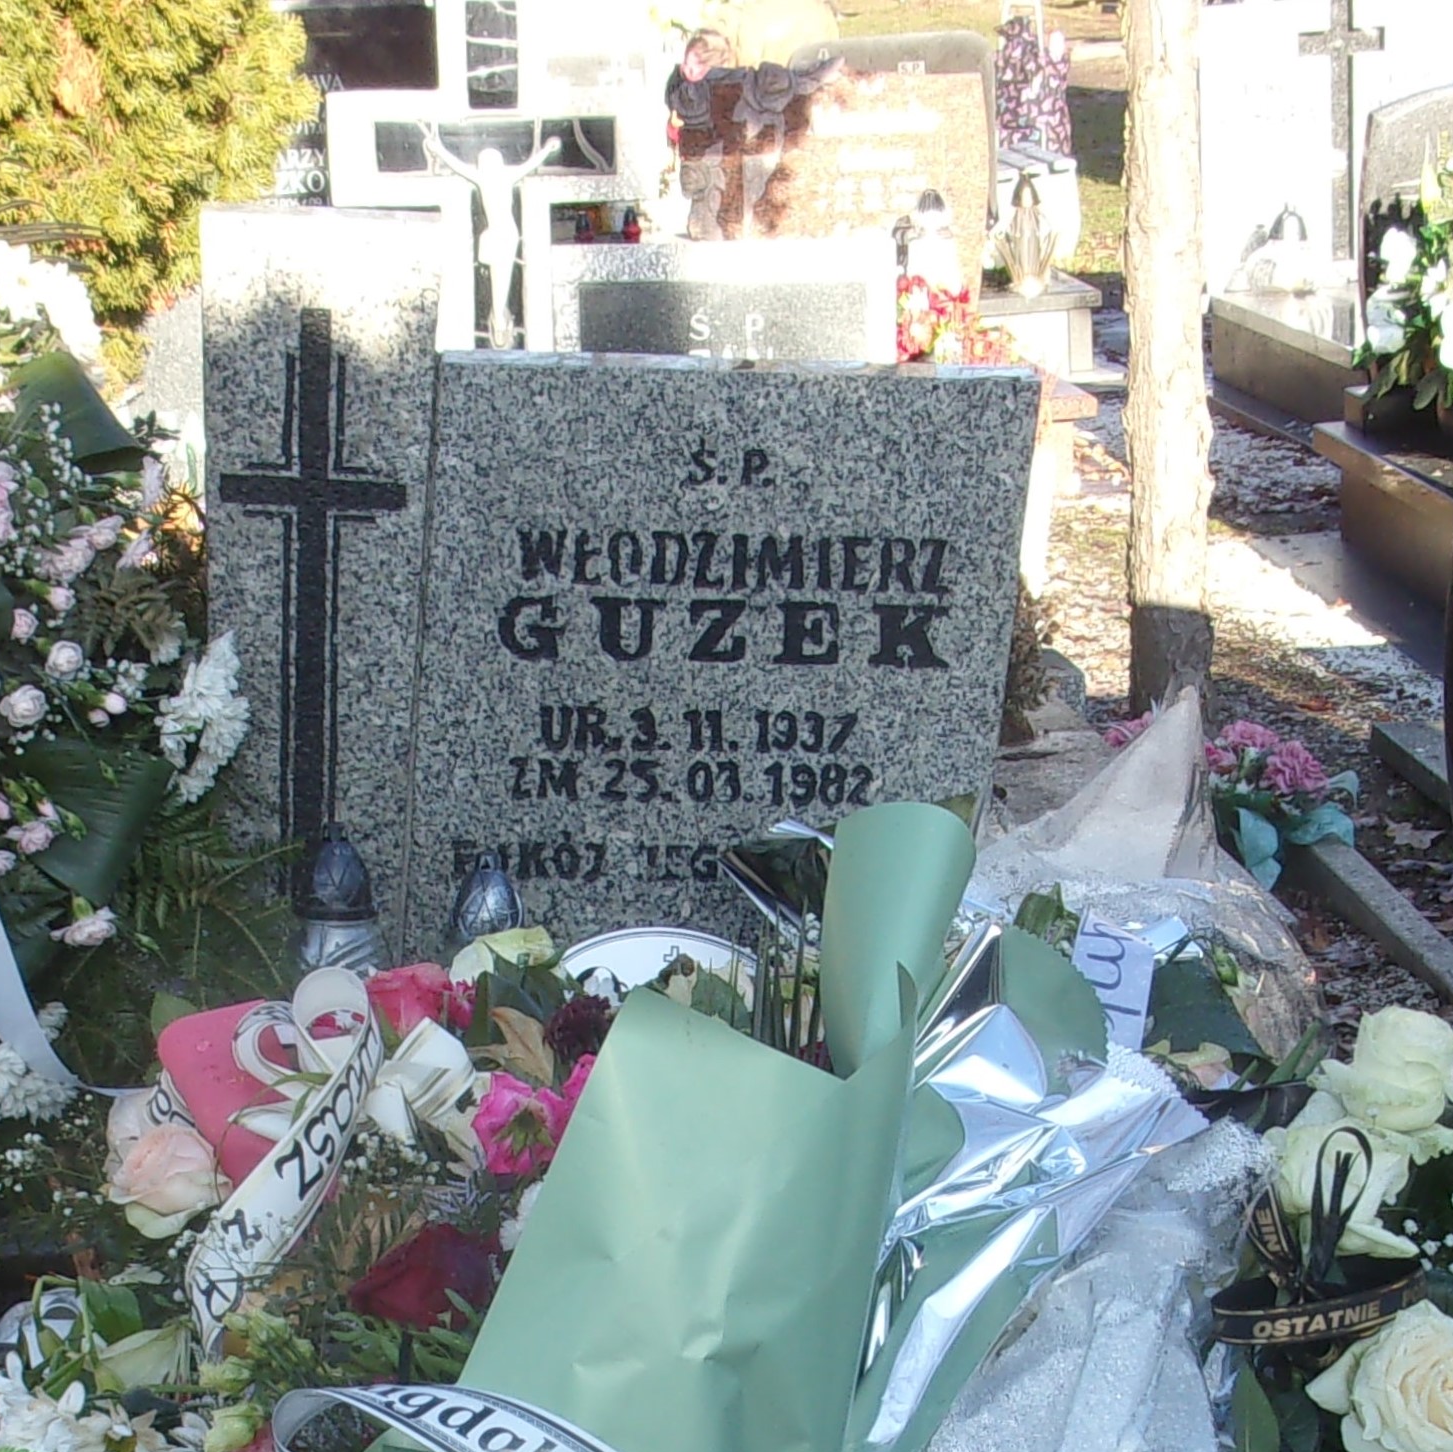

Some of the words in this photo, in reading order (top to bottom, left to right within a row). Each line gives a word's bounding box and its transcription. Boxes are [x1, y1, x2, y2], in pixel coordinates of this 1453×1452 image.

[516, 529, 950, 596] WŁODZIMIERZ
[497, 597, 950, 670] GUZEK
[754, 709, 860, 754] 1937
[764, 760, 875, 807] 1982
[1251, 1301, 1382, 1339] OSTATNIE
